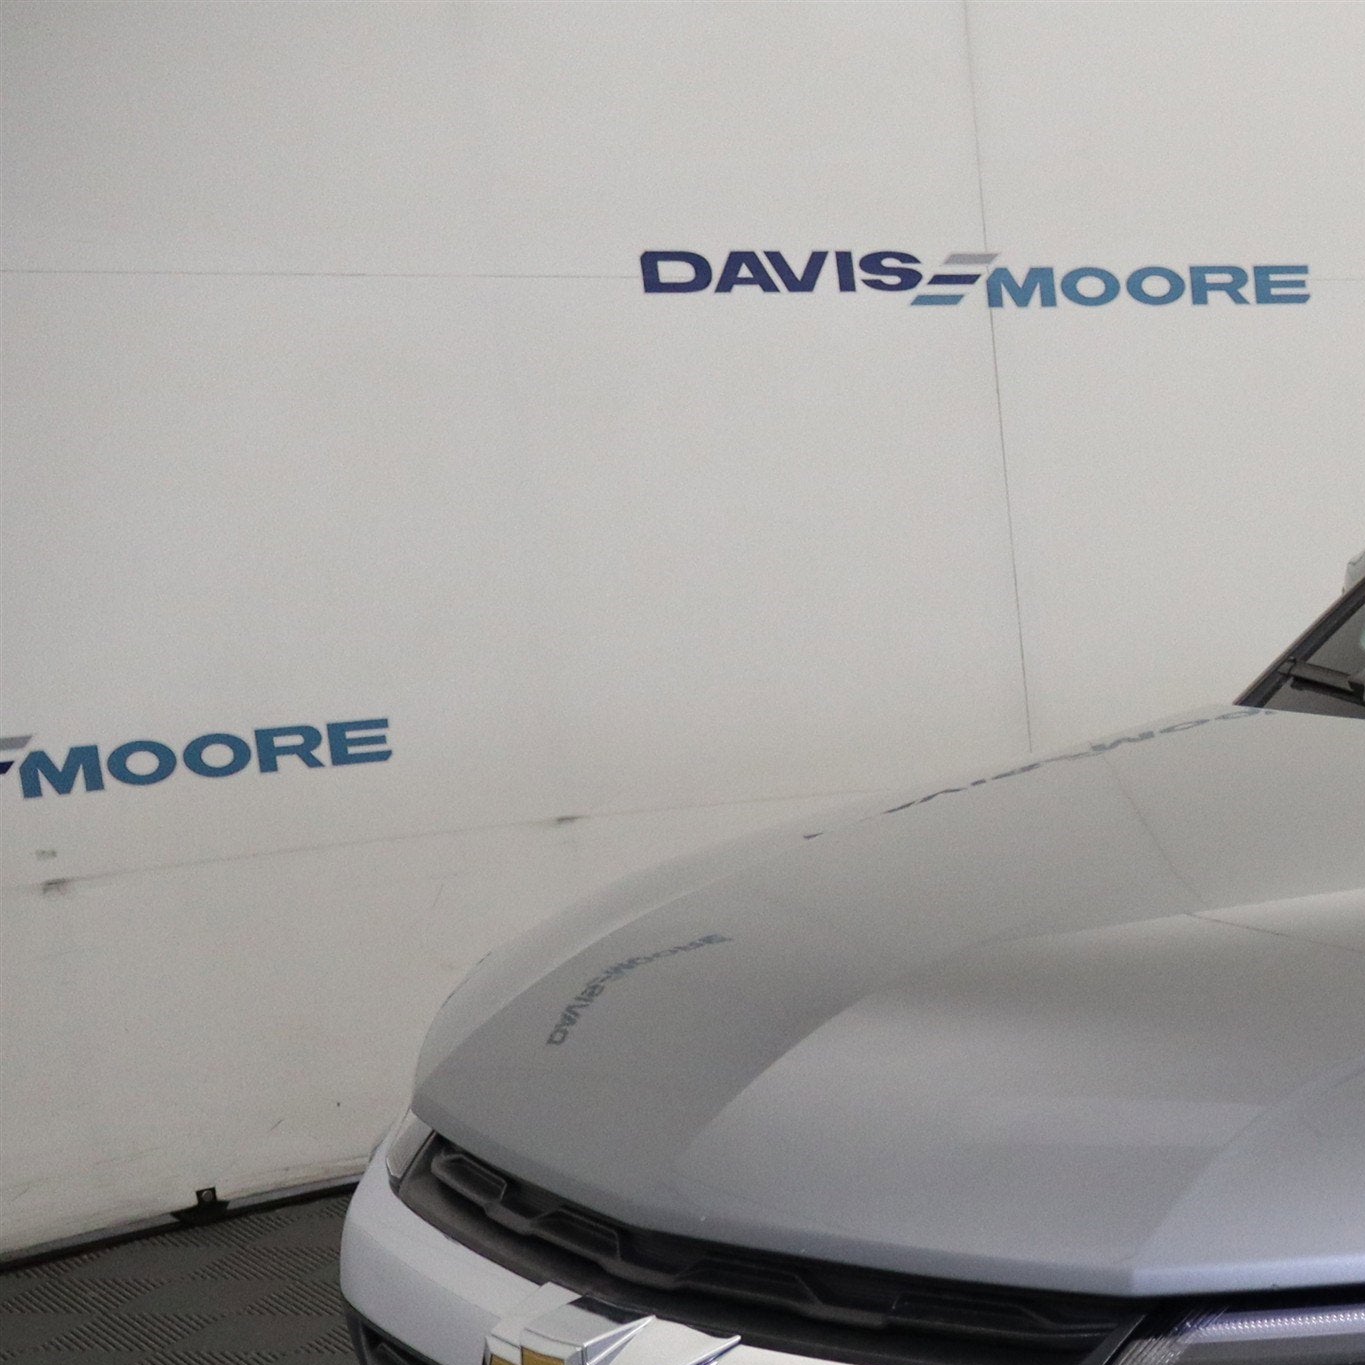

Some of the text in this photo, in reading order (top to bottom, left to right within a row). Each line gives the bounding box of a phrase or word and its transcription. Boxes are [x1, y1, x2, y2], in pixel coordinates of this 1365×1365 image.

[639, 249, 1311, 309] DAVIS MOORE
[18, 717, 394, 800] MOORE
